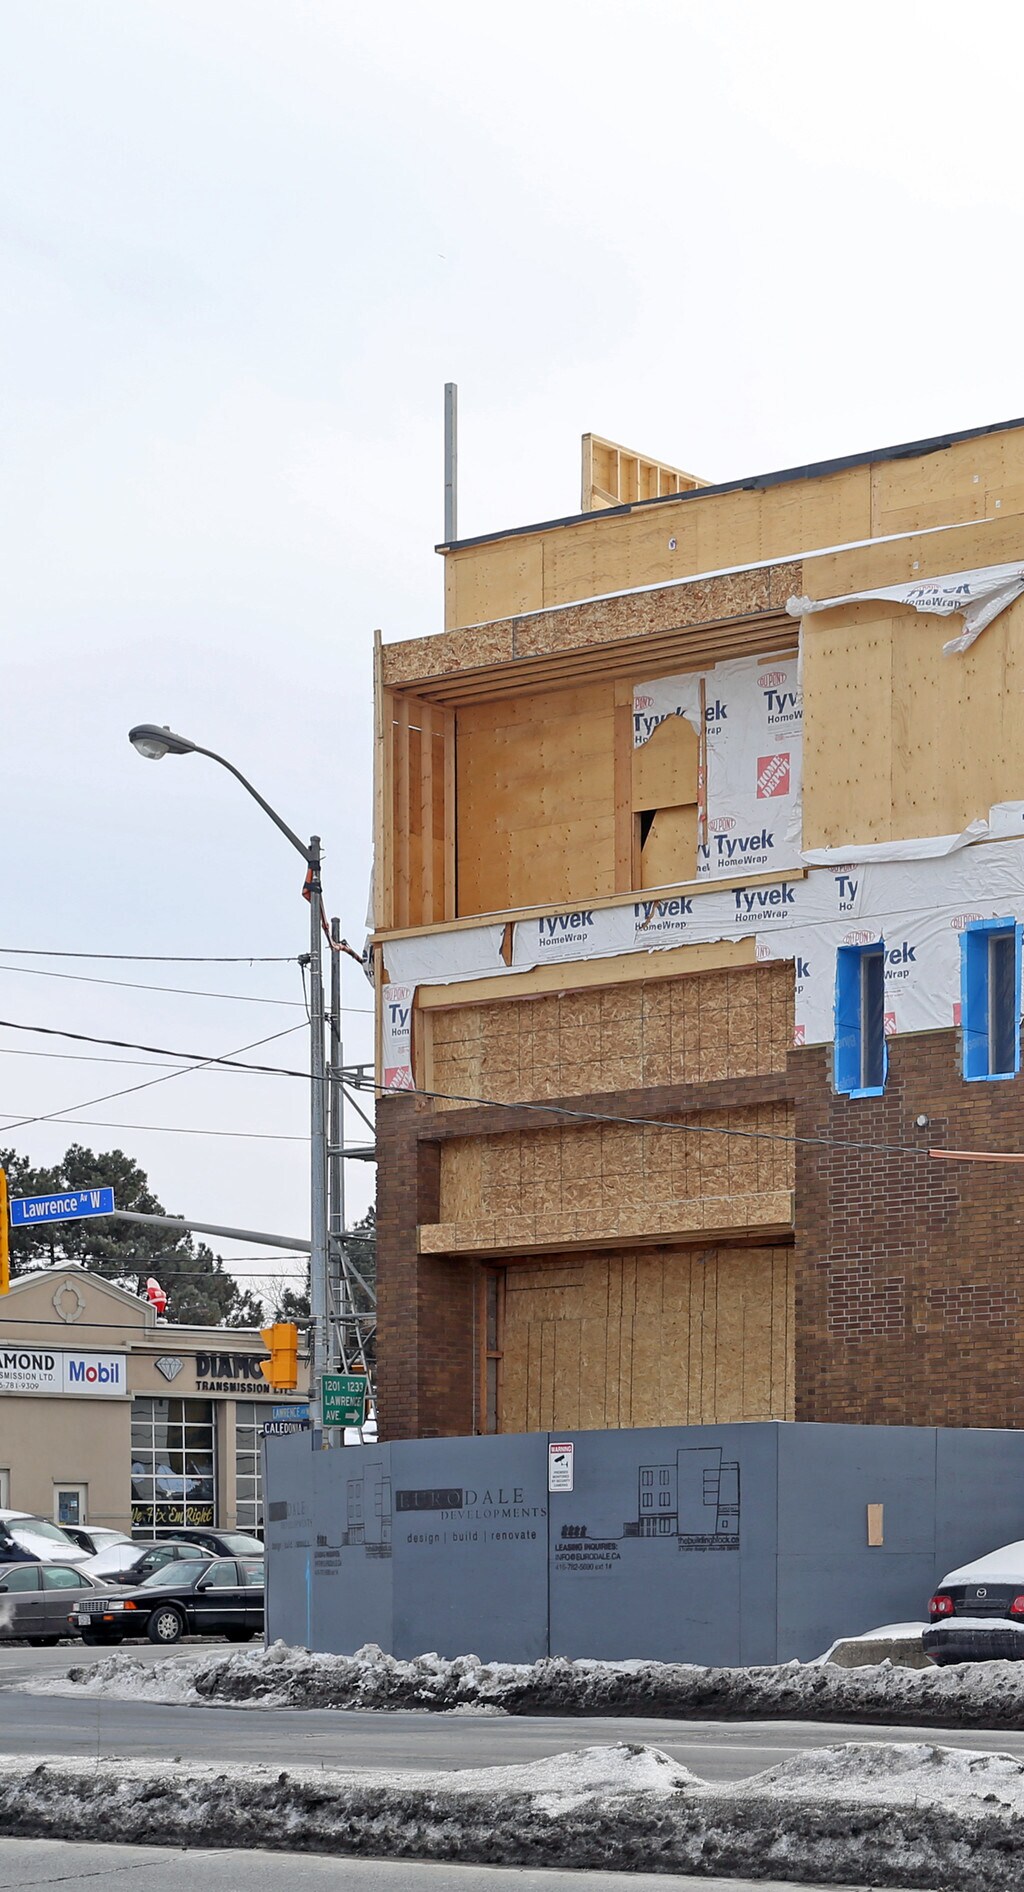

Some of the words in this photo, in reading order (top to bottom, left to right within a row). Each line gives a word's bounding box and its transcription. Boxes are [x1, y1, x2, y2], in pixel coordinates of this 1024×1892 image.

[758, 672, 787, 688] DUPONT
[709, 817, 736, 832] DUPONT
[714, 829, 775, 858] Tyvek
[717, 855, 768, 868] HomeWrap
[732, 883, 796, 909] Tyvek
[735, 908, 788, 923] HomeWrap
[538, 911, 594, 937] Tyvek
[539, 932, 588, 947] HomeWrap
[843, 929, 876, 945] DUPONT
[22, 1197, 78, 1218] Lawrence
[90, 1191, 100, 1209] W
[0, 1353, 55, 1371] MOND
[195, 1353, 265, 1380] DIAMO
[39, 1373, 55, 1382] LTD.
[69, 1361, 119, 1383] Mobil
[196, 1381, 270, 1393] TRANSMISSION
[325, 1381, 340, 1391] 1201
[325, 1395, 362, 1406] LAWRENCE
[145, 1507, 166, 1522] Fix
[186, 1506, 213, 1526] Right
[441, 1507, 547, 1520] DEVELOPMENTS
[407, 1533, 440, 1544] design
[452, 1531, 478, 1541] build
[491, 1529, 537, 1541] renovate
[555, 1543, 583, 1551] LEASING
